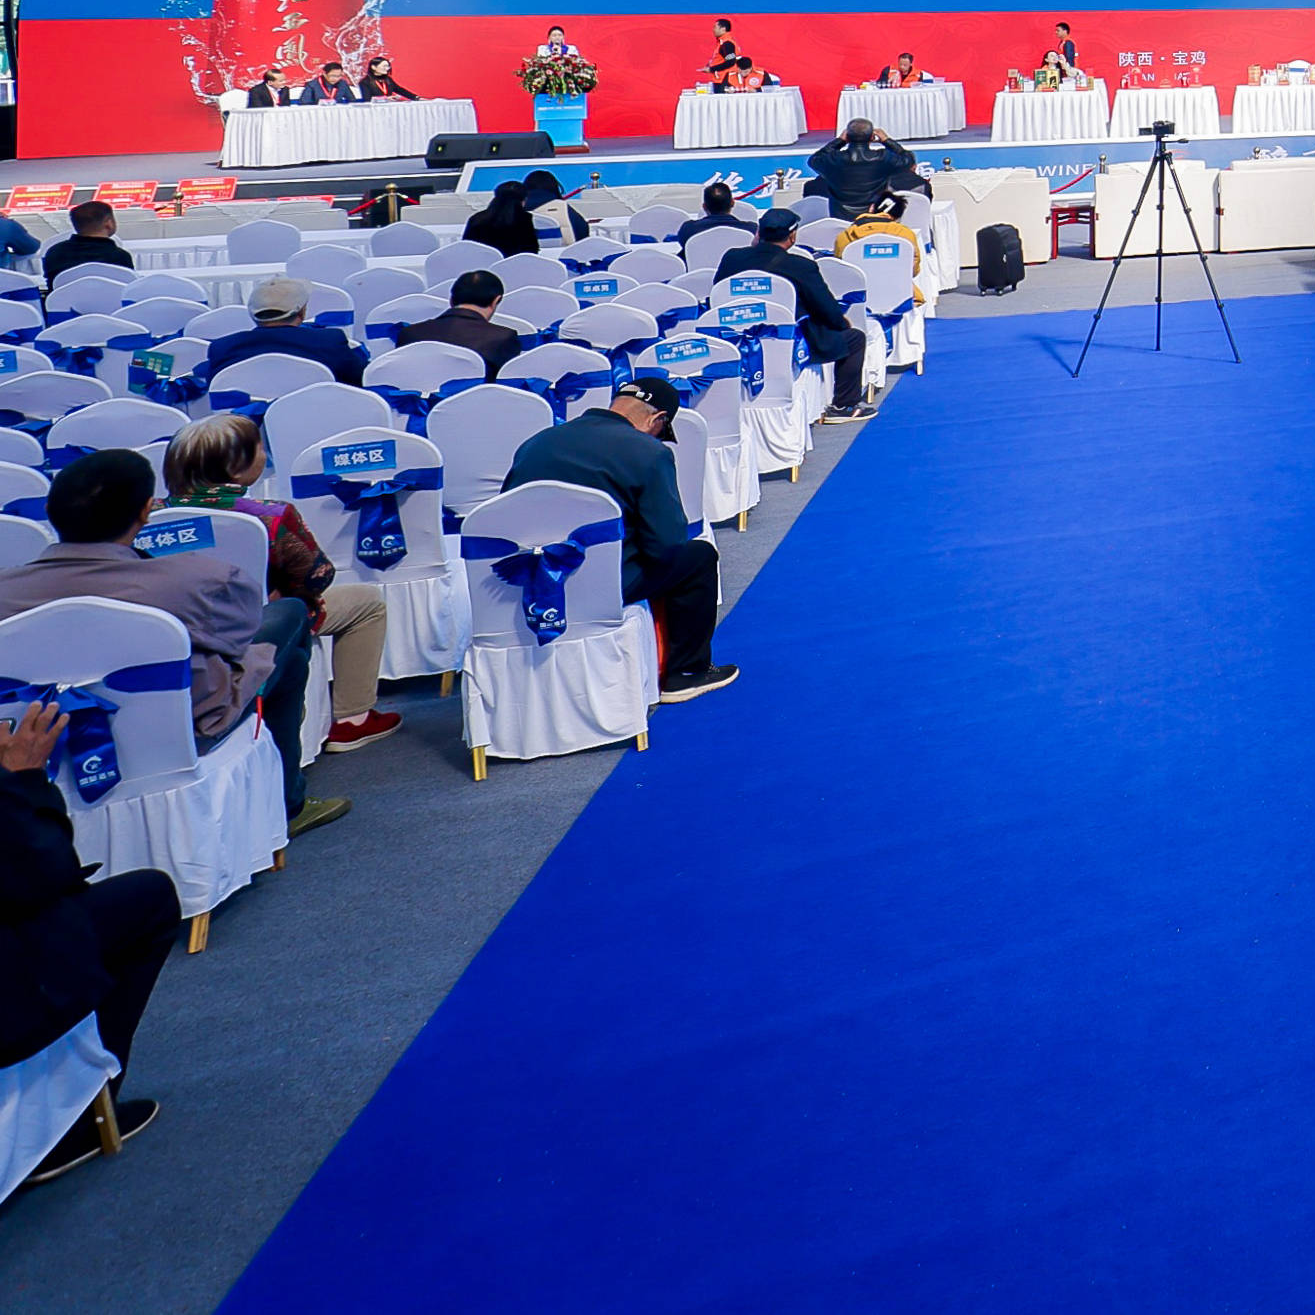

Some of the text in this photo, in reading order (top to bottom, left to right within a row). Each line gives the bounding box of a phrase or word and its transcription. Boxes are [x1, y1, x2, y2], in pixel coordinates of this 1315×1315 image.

[333, 448, 385, 468] 媒体区
[133, 527, 198, 551] 媒体区
